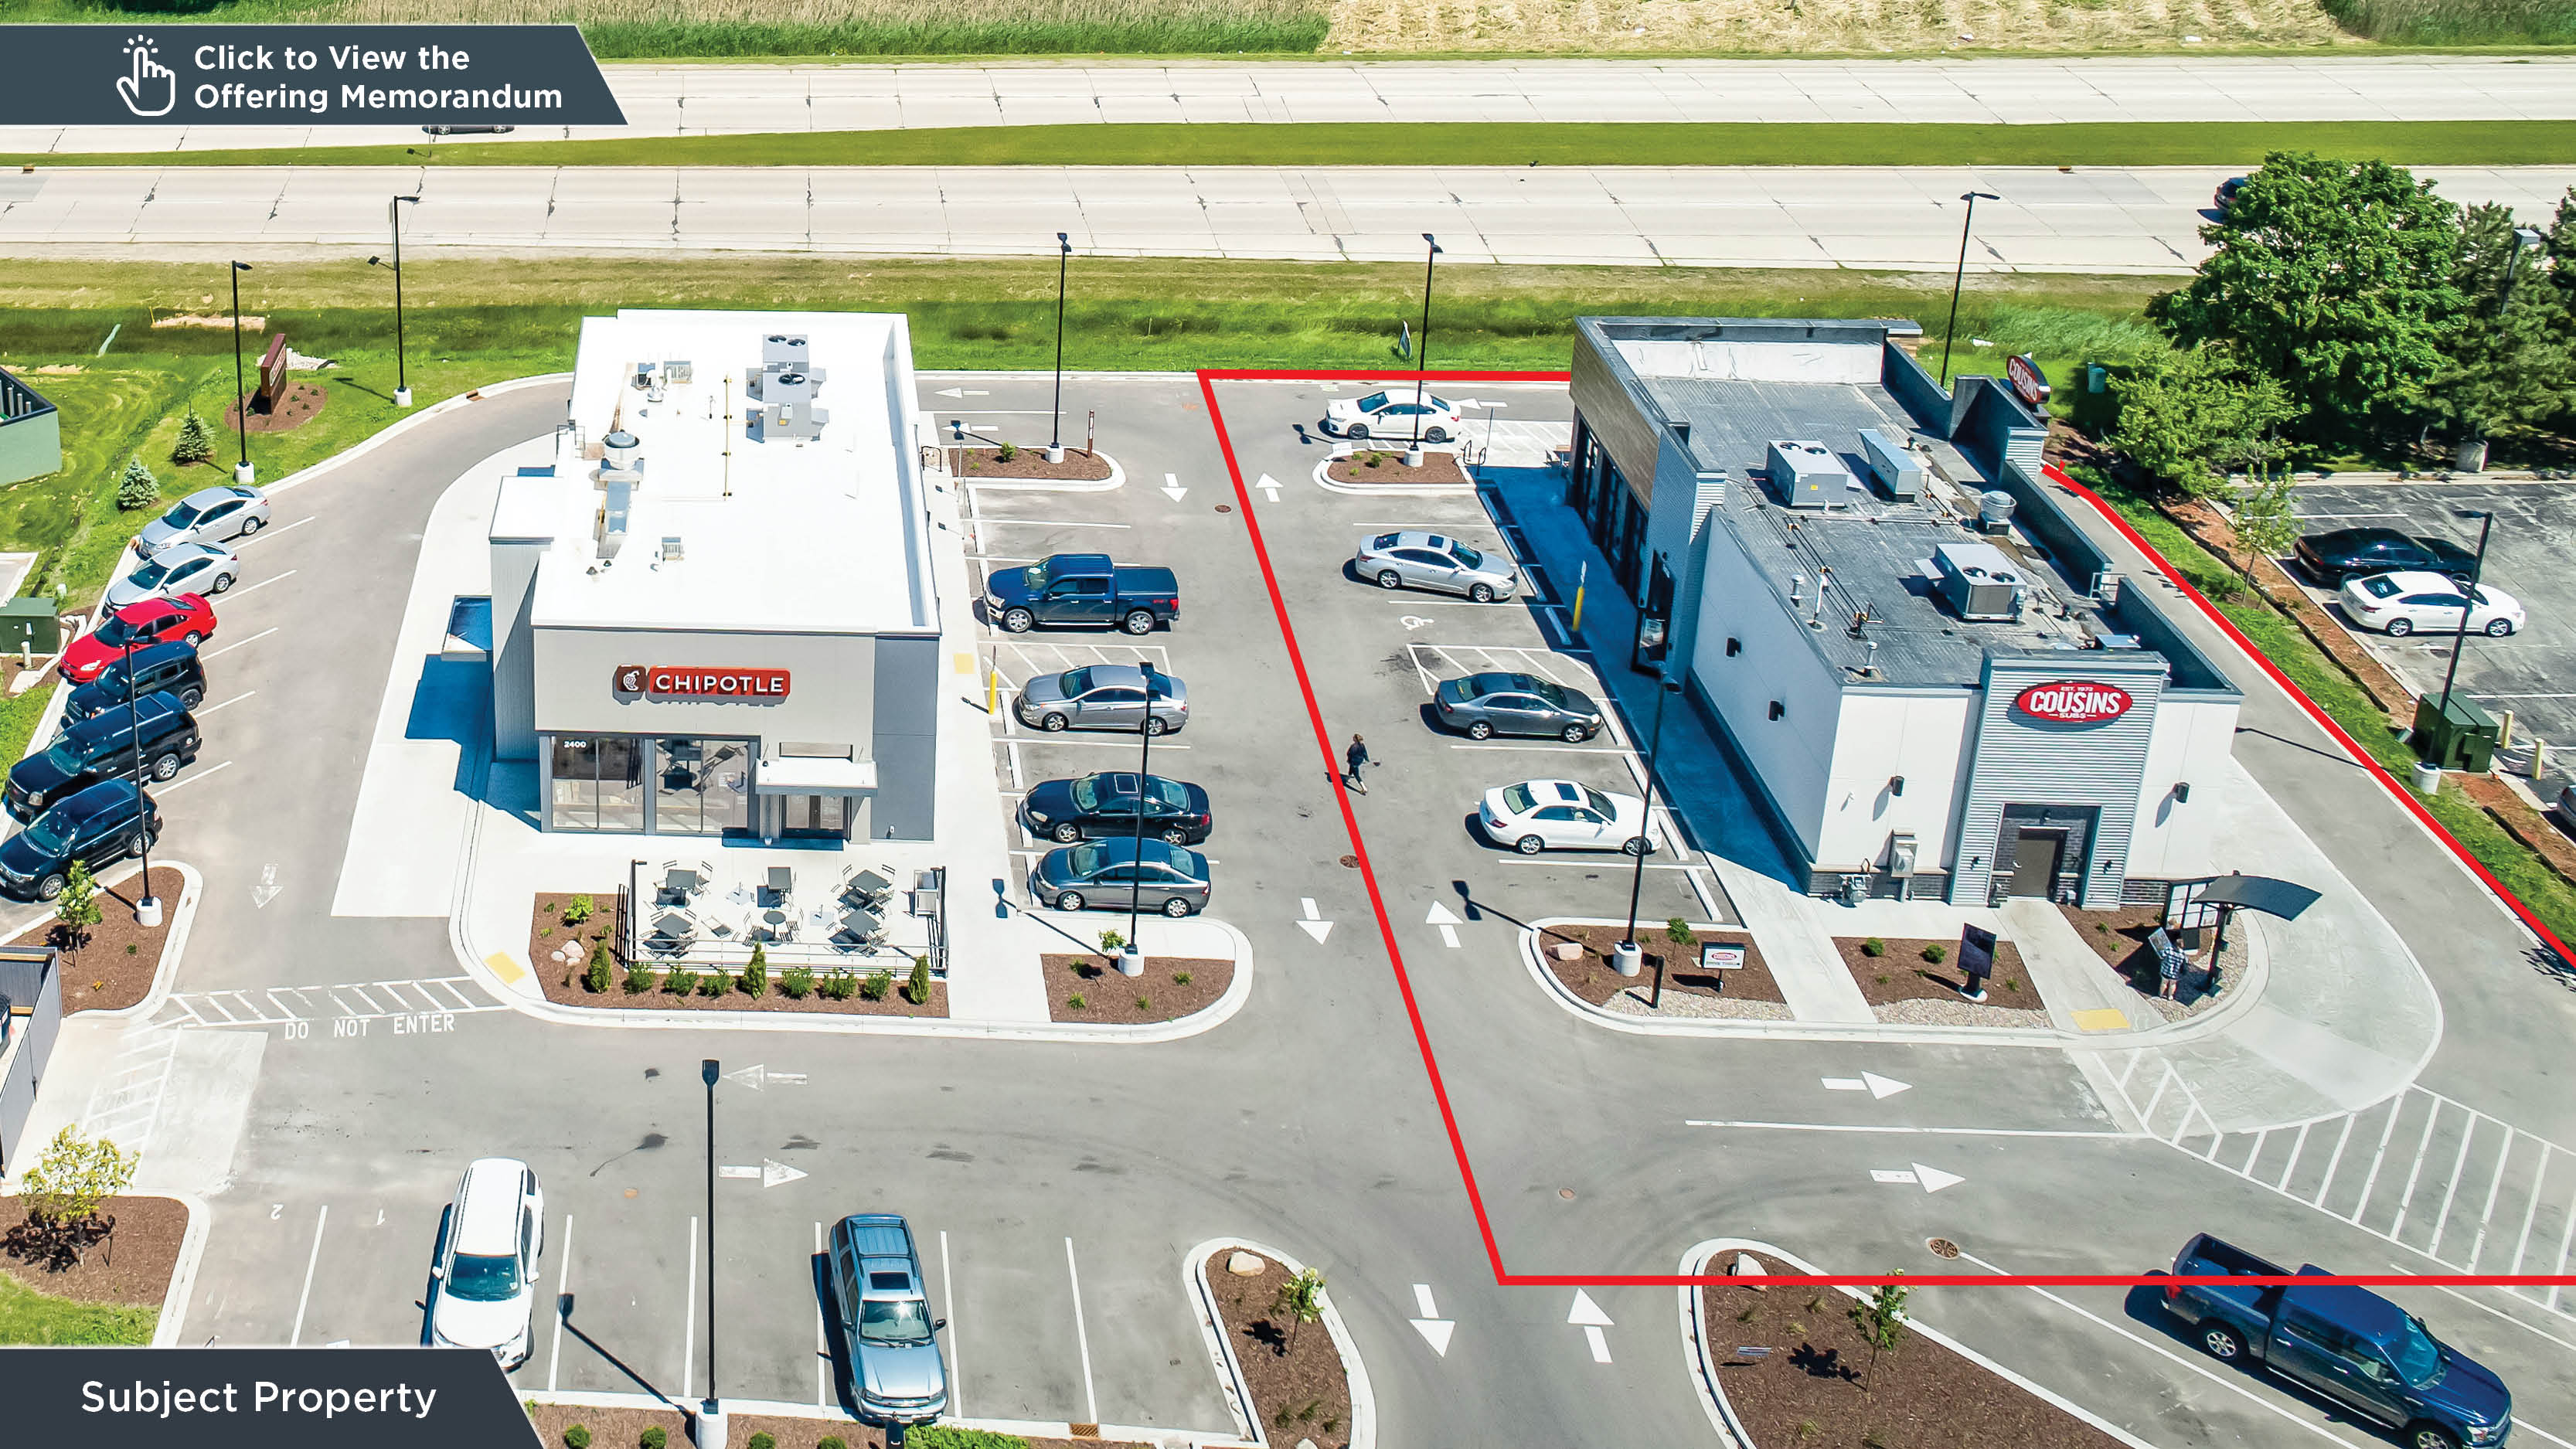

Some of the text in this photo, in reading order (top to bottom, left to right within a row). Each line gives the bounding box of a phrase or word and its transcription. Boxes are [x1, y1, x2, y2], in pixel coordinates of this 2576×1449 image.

[2009, 358, 2039, 401] COUSINS
[655, 675, 784, 692] CHIPOTLE
[2030, 690, 2122, 714] COUSINS
[563, 740, 587, 749] 2400
[284, 1012, 455, 1040] DO NOT ENTER
